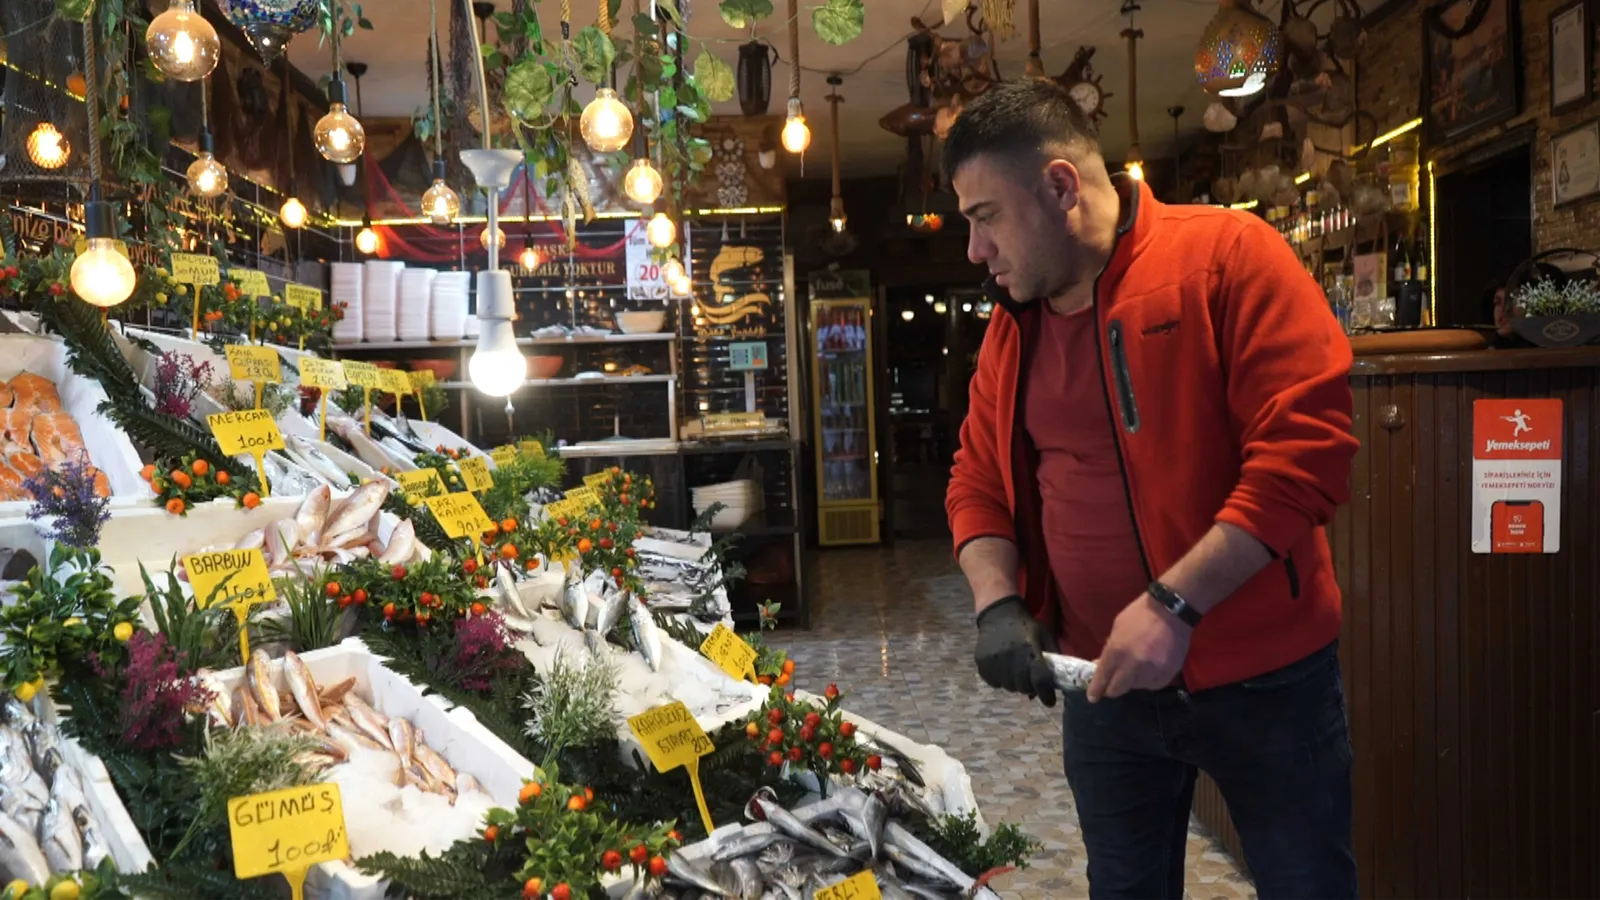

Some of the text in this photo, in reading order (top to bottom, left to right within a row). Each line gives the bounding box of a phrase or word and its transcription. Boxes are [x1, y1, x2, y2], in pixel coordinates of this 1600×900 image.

[563, 261, 615, 277] YOKTUR
[209, 411, 270, 426] MERCAN
[1486, 439, 1550, 452] Yemeksepeti
[190, 551, 252, 575] BARBUN
